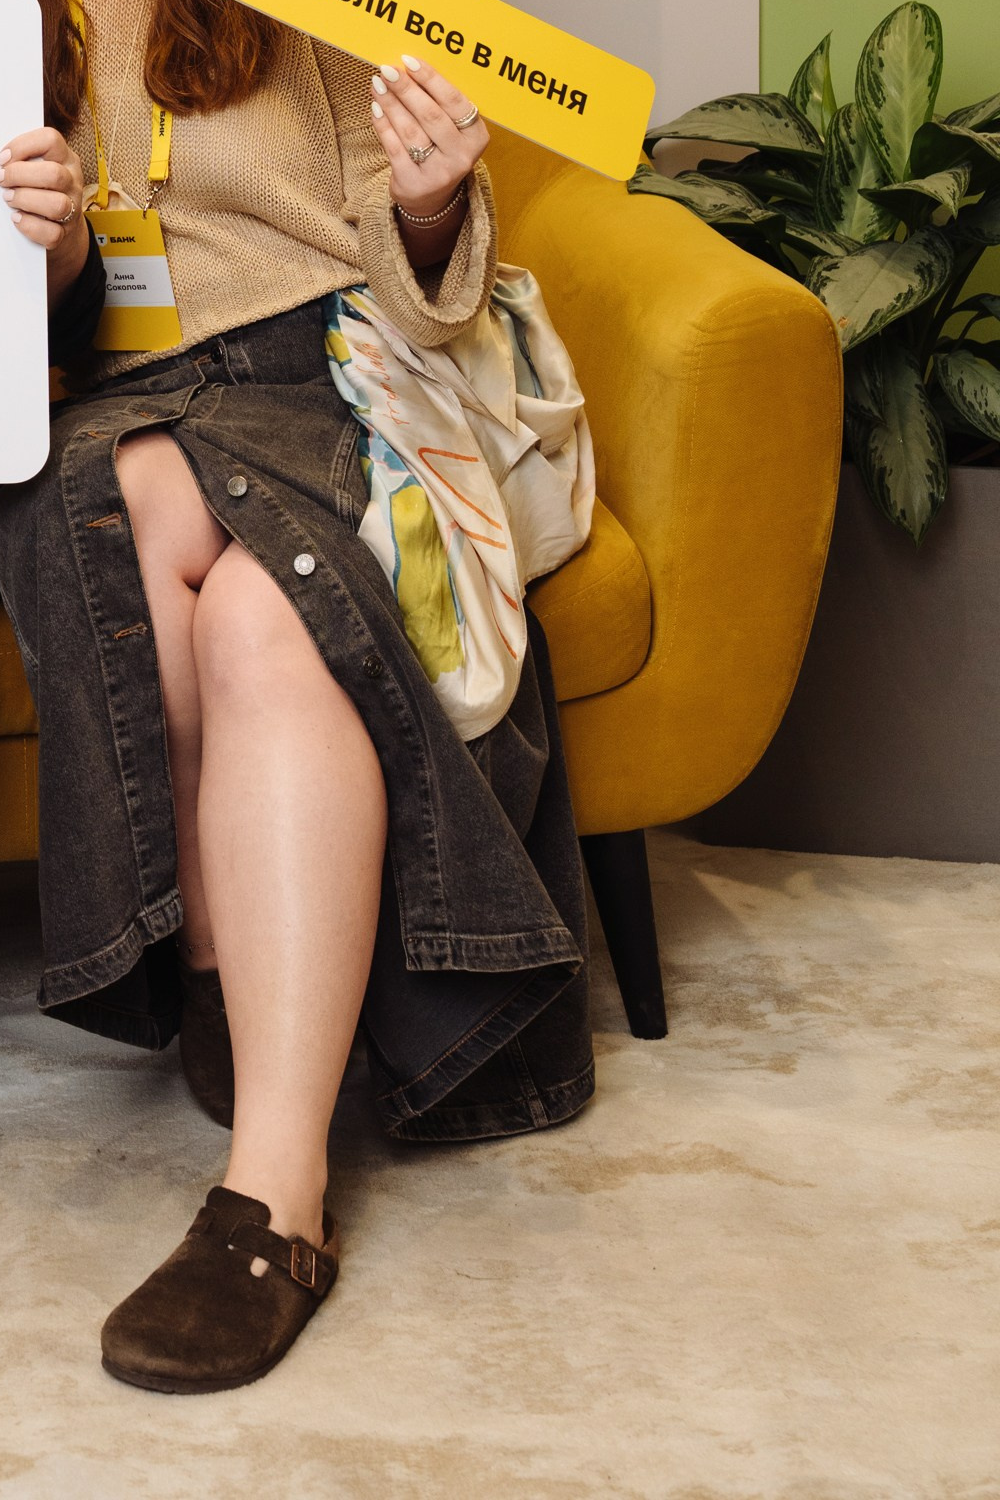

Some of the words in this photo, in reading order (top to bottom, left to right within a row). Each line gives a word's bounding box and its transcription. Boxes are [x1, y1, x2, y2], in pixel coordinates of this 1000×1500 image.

[404, 9, 465, 55] все
[471, 41, 493, 69] в
[498, 54, 589, 116] меня
[109, 236, 136, 244] БАНК
[113, 273, 135, 281] Анна
